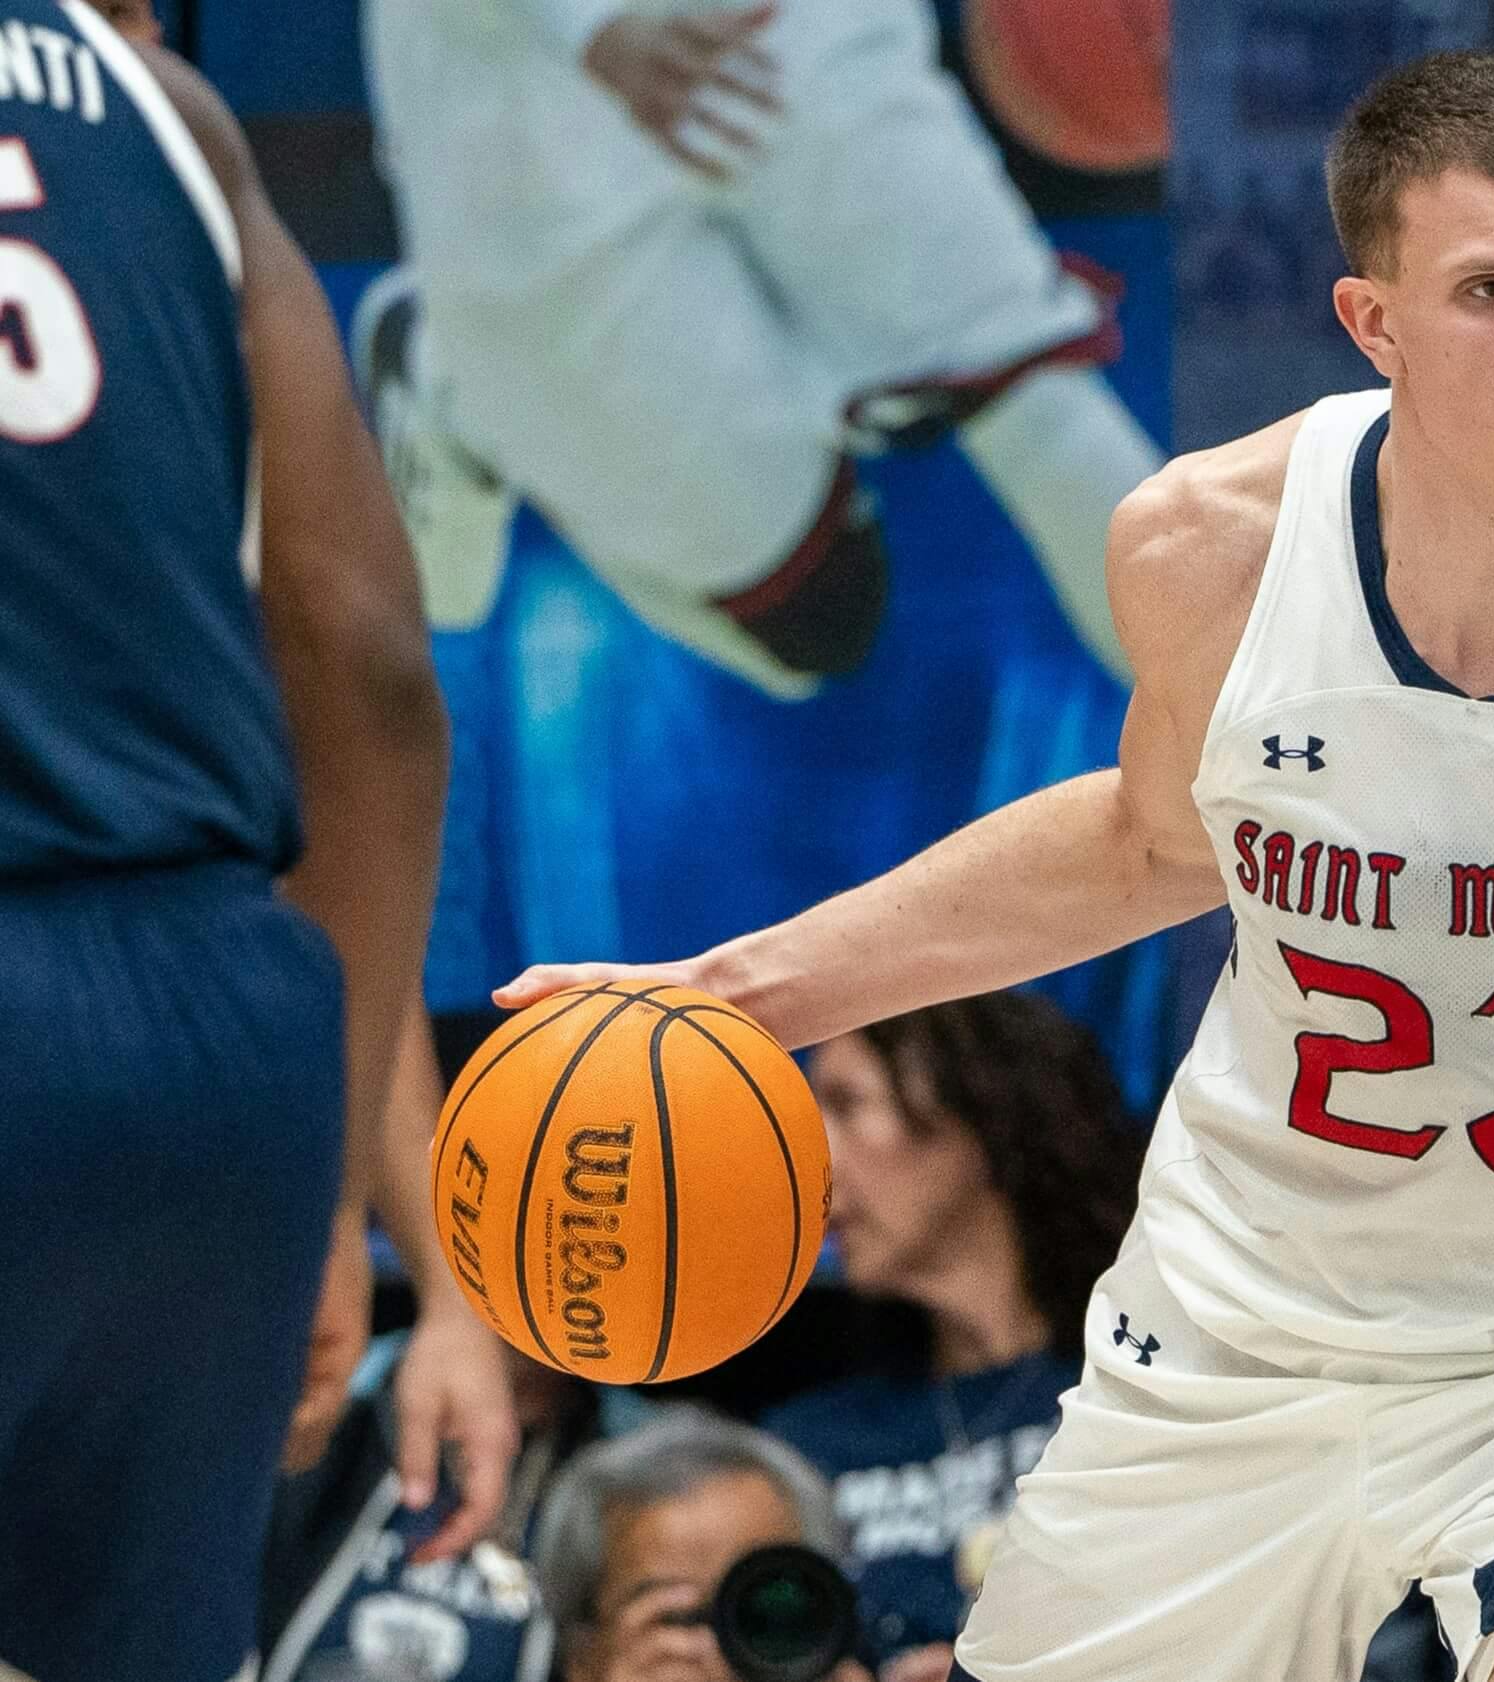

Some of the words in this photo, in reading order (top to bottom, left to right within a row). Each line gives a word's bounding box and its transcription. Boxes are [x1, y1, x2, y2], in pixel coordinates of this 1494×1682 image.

[1233, 820, 1406, 930] SAINT
[545, 1199, 554, 1248] INDOOR
[558, 1119, 636, 1360] Wilson
